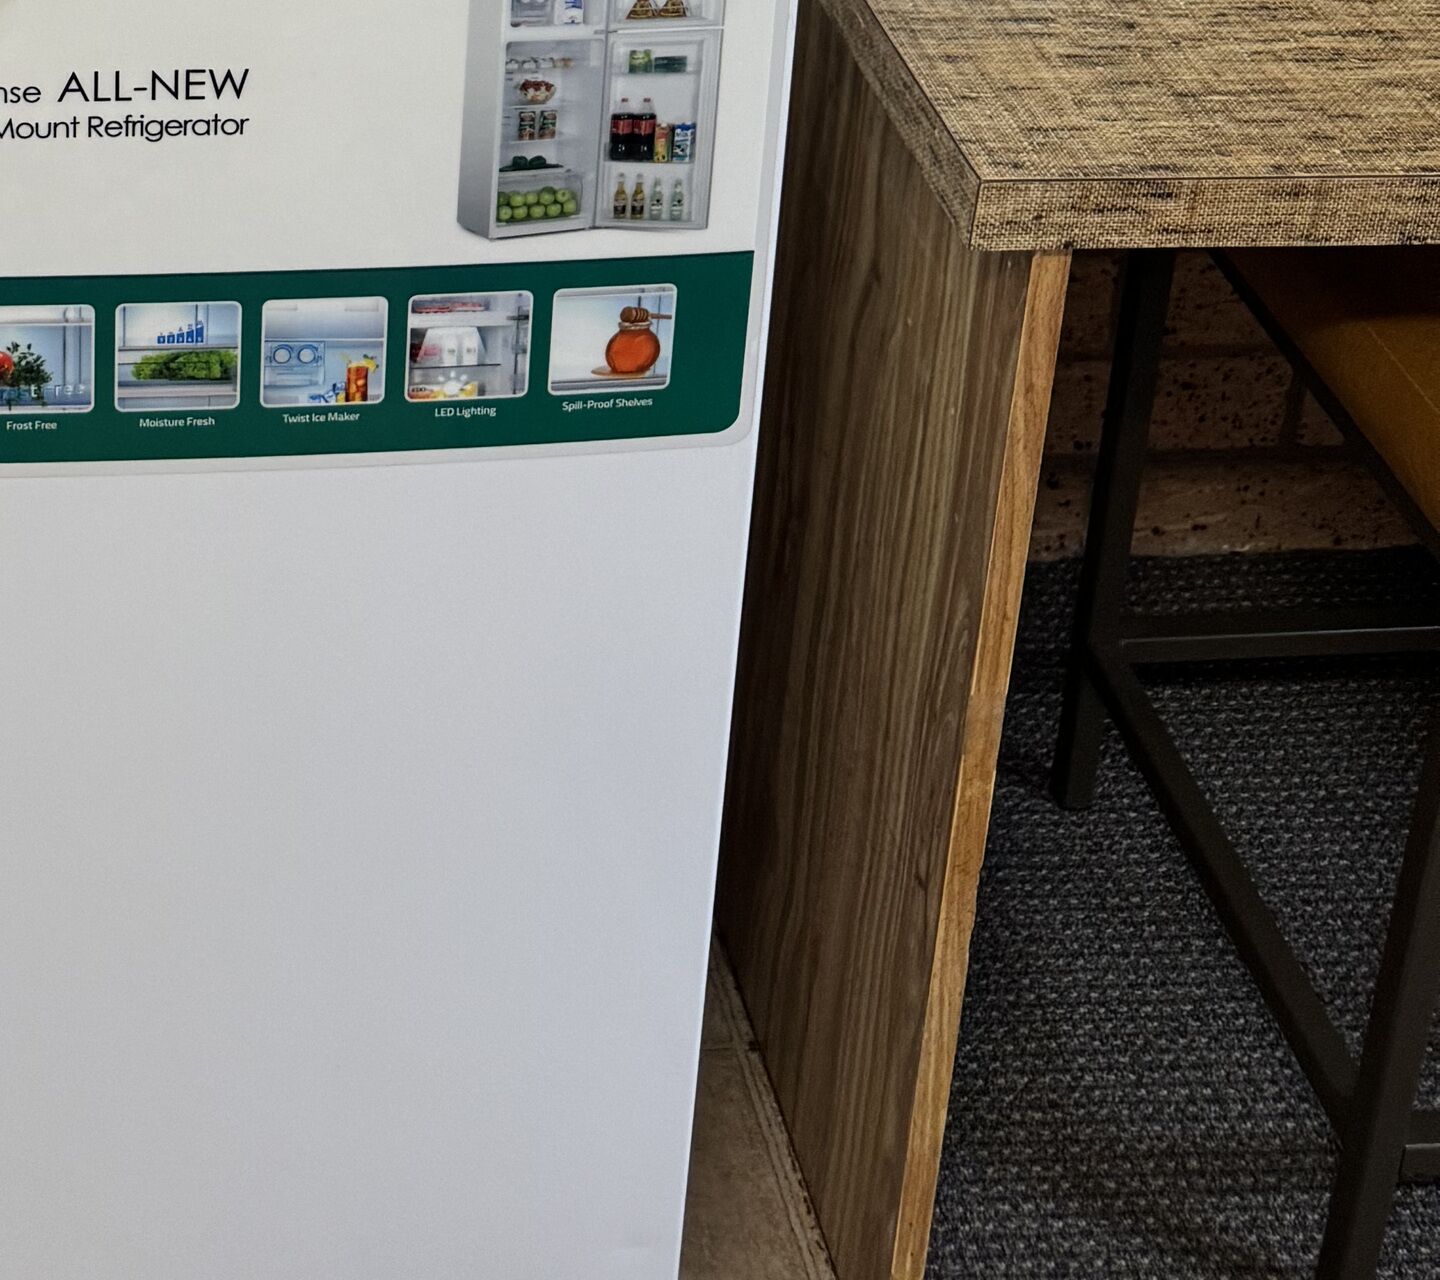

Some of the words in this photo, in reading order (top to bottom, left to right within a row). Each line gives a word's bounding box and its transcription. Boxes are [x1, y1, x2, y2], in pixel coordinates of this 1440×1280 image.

[57, 68, 250, 103] ALL-NEW
[87, 113, 250, 143] Refrigerator
[562, 398, 615, 413] Spill-Proof
[615, 397, 653, 408] Shelves
[282, 413, 310, 424] Twist
[311, 412, 326, 423] Ice
[327, 411, 360, 422] Maker
[434, 407, 455, 418] LED
[456, 406, 497, 419] Lighting
[6, 420, 33, 431] Frost
[34, 420, 58, 430] Free
[139, 417, 185, 429] Moisture
[186, 415, 217, 427] Fresh
